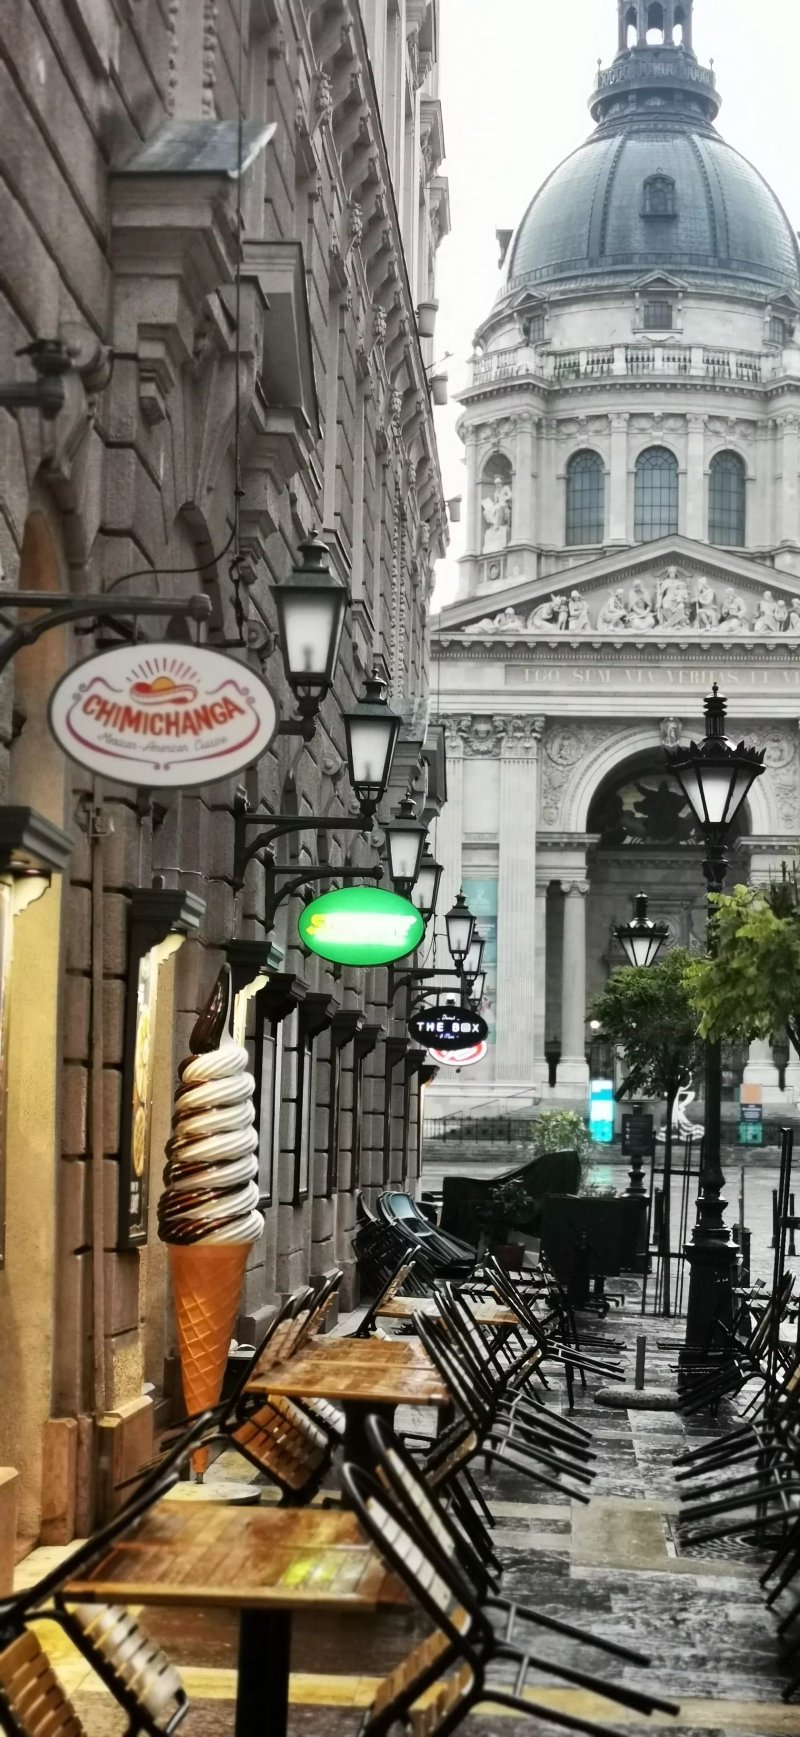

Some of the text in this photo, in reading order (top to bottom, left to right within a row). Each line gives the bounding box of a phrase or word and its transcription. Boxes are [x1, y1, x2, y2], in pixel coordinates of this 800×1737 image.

[524, 669, 561, 682] EGO
[572, 669, 611, 682] SUM
[625, 670, 656, 683] VIA
[667, 670, 739, 684] VERITAS
[751, 671, 772, 684] ET
[82, 693, 245, 738] CHIMICHANGA
[97, 733, 228, 753] Mexican-American Cuisine
[417, 1021, 480, 1033] THE BOX
